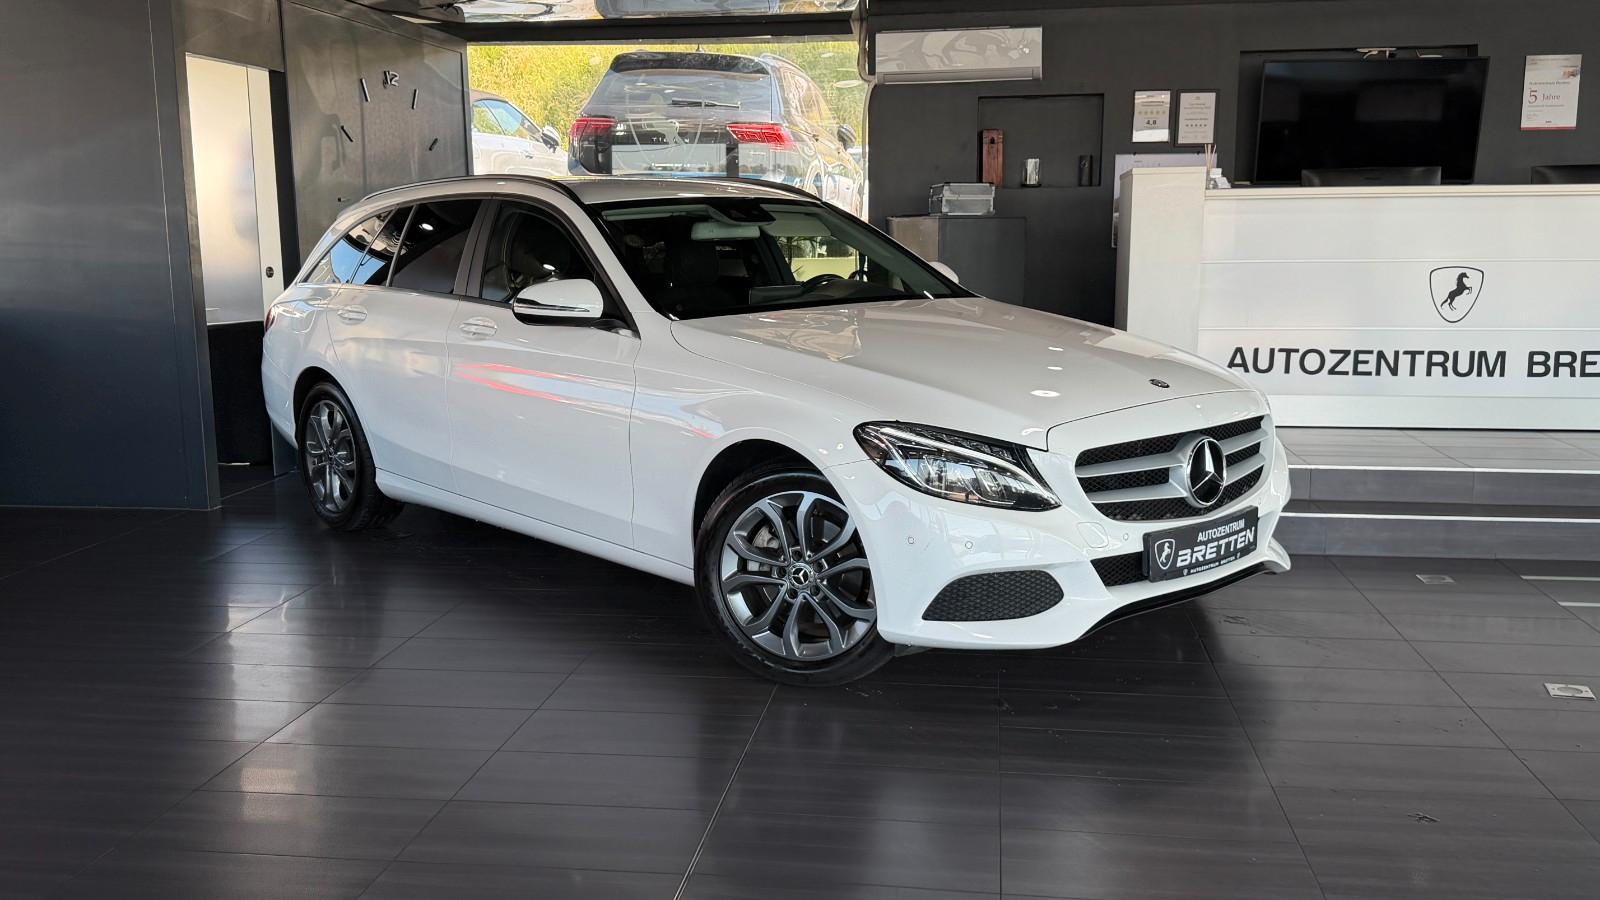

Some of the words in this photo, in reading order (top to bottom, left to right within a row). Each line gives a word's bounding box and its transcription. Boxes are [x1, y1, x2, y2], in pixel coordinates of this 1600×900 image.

[384, 70, 399, 87] 12
[1528, 89, 1538, 104] 5
[1542, 93, 1561, 101] Jahre
[1226, 346, 1507, 378] AUTOZENTRUM
[1526, 350, 1600, 378] BRE
[1196, 518, 1245, 543] AUTOZENTRUM
[1176, 526, 1255, 568] BRETTEN
